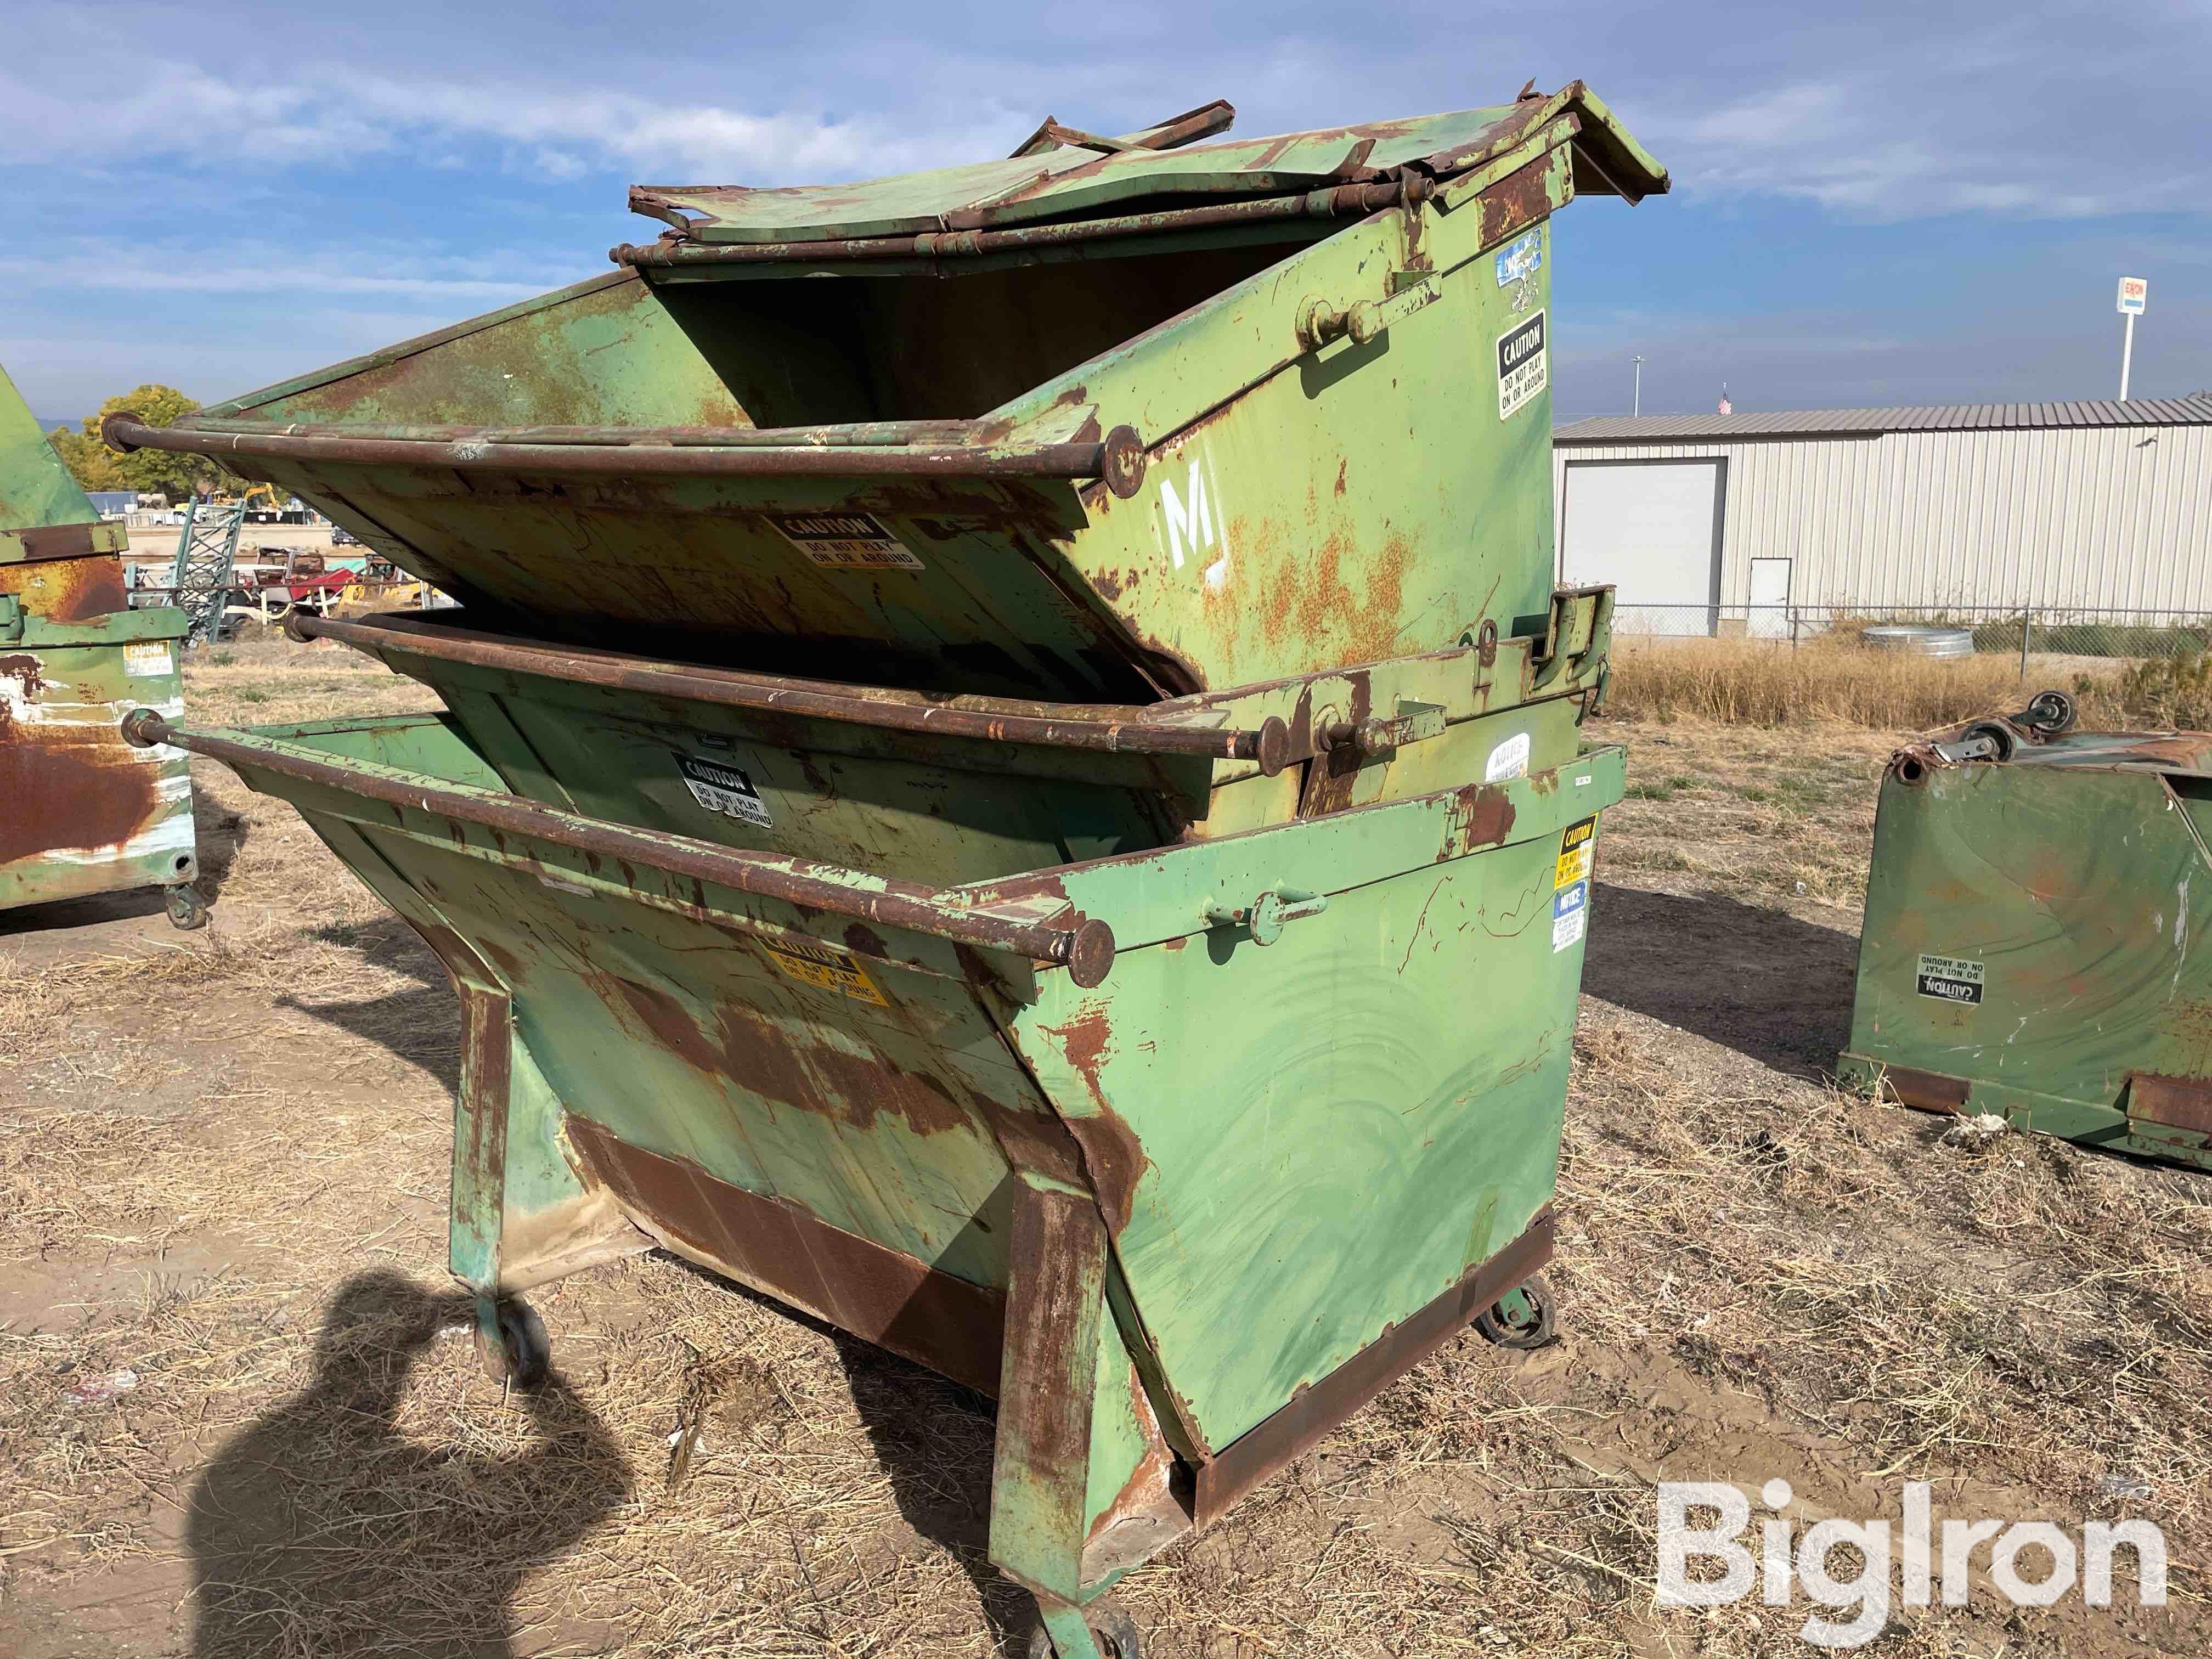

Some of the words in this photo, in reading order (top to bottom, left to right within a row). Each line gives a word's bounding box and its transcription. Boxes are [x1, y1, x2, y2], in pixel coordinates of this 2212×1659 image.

[1504, 324, 1540, 366] CAUTION
[1505, 378, 1513, 392] DO
[1515, 366, 1526, 384] NOT
[1529, 355, 1541, 374] PLAY
[1502, 396, 1510, 409] ON
[1513, 387, 1521, 401] OR
[1524, 369, 1544, 394] AROUND
[783, 518, 874, 534] CAUTION
[805, 542, 826, 551] DO
[829, 542, 857, 551] NOT
[860, 541, 894, 551] PLAY
[812, 553, 833, 562] ON
[836, 553, 855, 562] OR
[860, 553, 913, 563] AROUND
[686, 761, 746, 790] CAUTION
[696, 785, 710, 797] DO
[713, 790, 733, 804] NOT
[736, 798, 759, 812] PLAY
[699, 795, 713, 807] ON
[733, 806, 772, 825] AROUND
[1566, 822, 1592, 847] CAUTION
[1561, 856, 1568, 867] DO
[1558, 870, 1564, 881] ON
[1560, 887, 1581, 911] NOTICE
[1922, 956, 1953, 967] AROUND
[1957, 961, 1967, 969] OR
[1972, 963, 1983, 972] ON
[778, 955, 797, 966] DO
[799, 961, 825, 975] NOT
[828, 969, 860, 984] PLAY
[783, 964, 803, 975] ON
[1925, 965, 1943, 974] PLAY
[1948, 969, 1962, 977] NOT
[1967, 971, 1978, 979] DO
[1926, 979, 1973, 997] CAUTION
